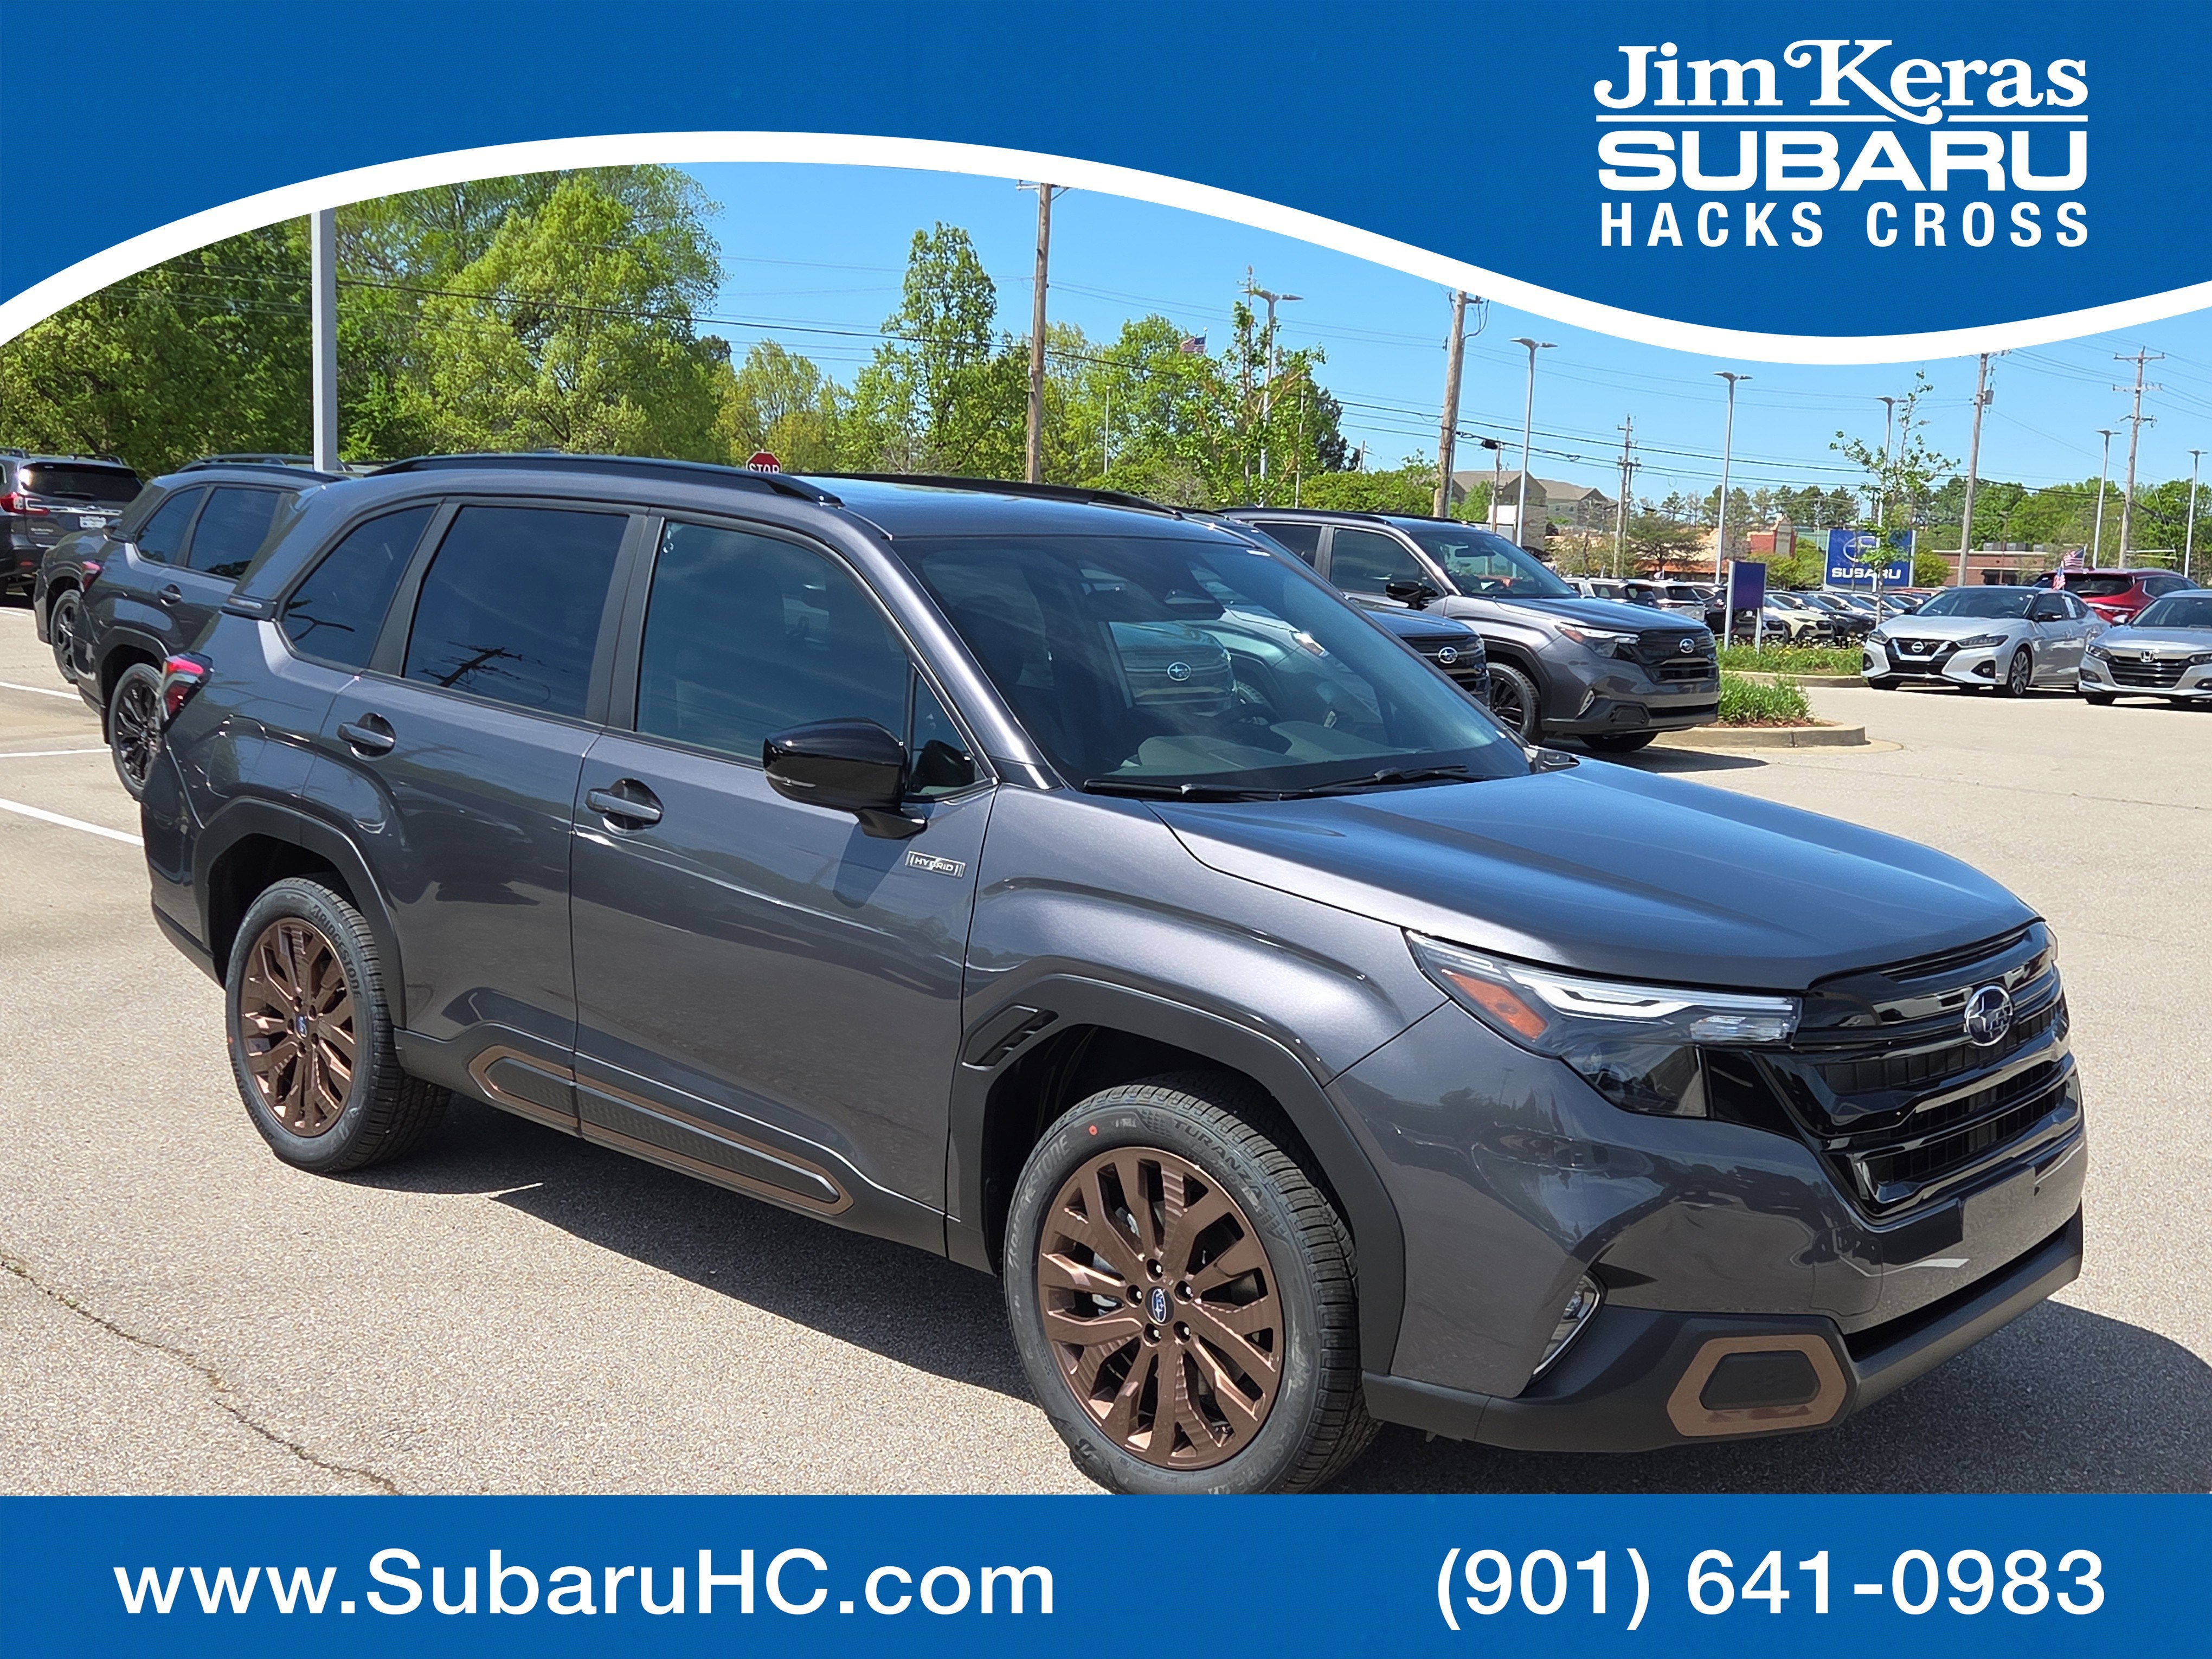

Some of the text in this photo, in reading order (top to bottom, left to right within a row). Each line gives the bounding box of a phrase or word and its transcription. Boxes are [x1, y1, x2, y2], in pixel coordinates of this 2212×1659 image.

[749, 463, 780, 474] STOP
[915, 857, 954, 871] HYBRID
[1173, 1118, 1263, 1200] TURANZA
